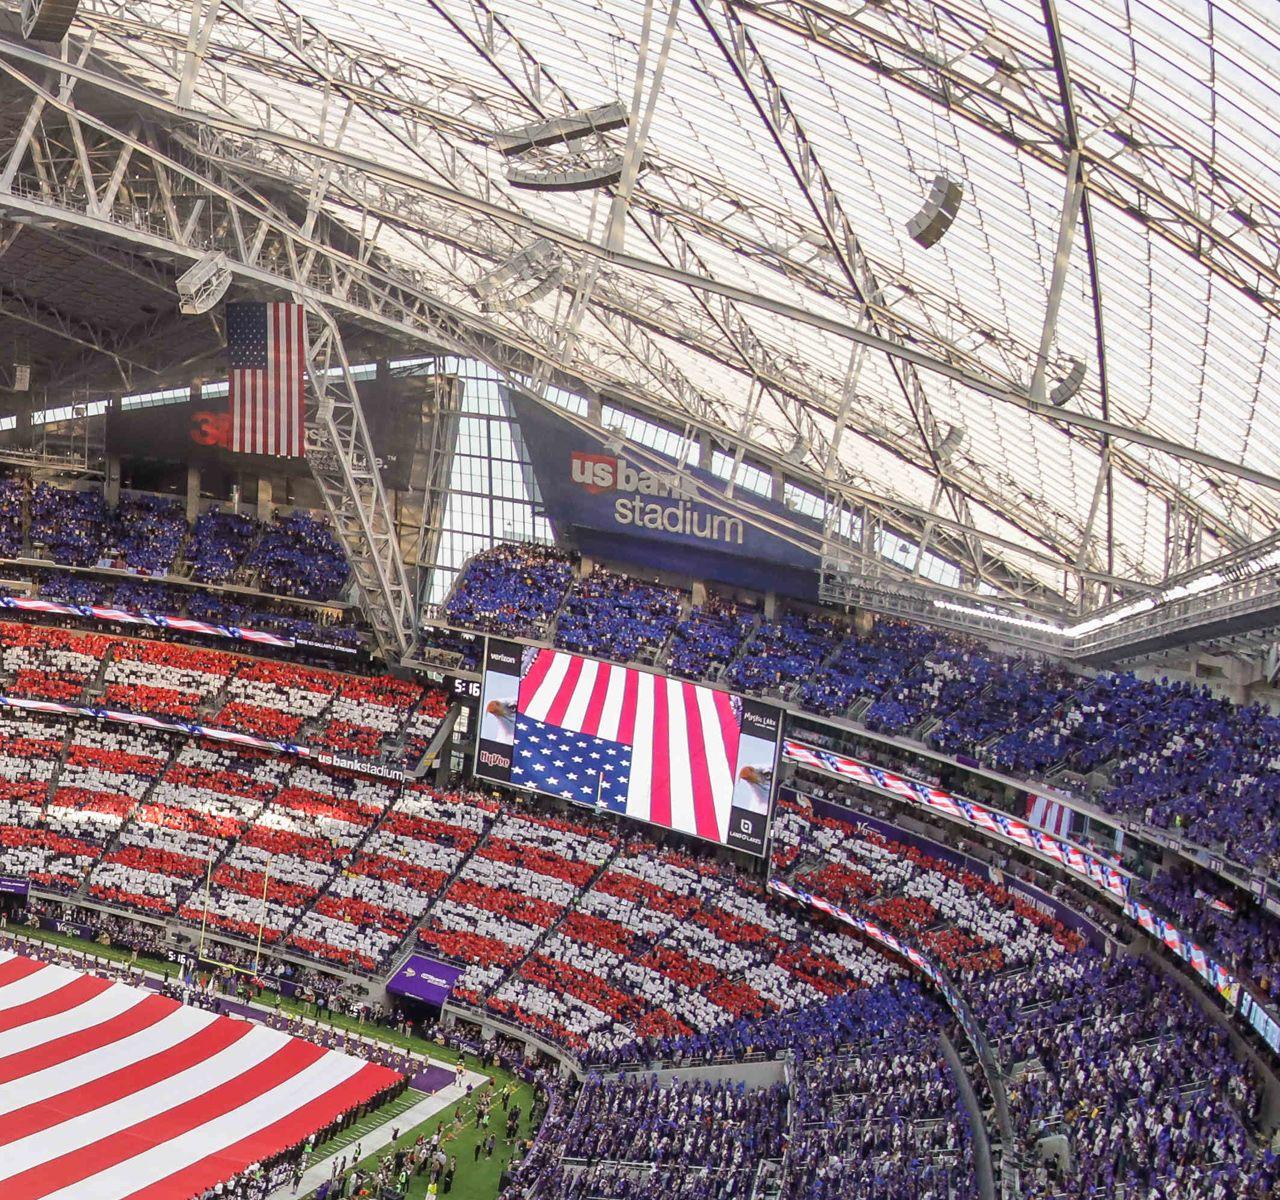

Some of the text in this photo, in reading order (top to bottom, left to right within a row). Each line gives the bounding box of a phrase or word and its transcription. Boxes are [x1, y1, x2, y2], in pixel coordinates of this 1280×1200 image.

[614, 496, 744, 544] stadium
[490, 652, 516, 664] verizon
[454, 679, 481, 697] 5:16
[168, 951, 186, 964] 5:16
